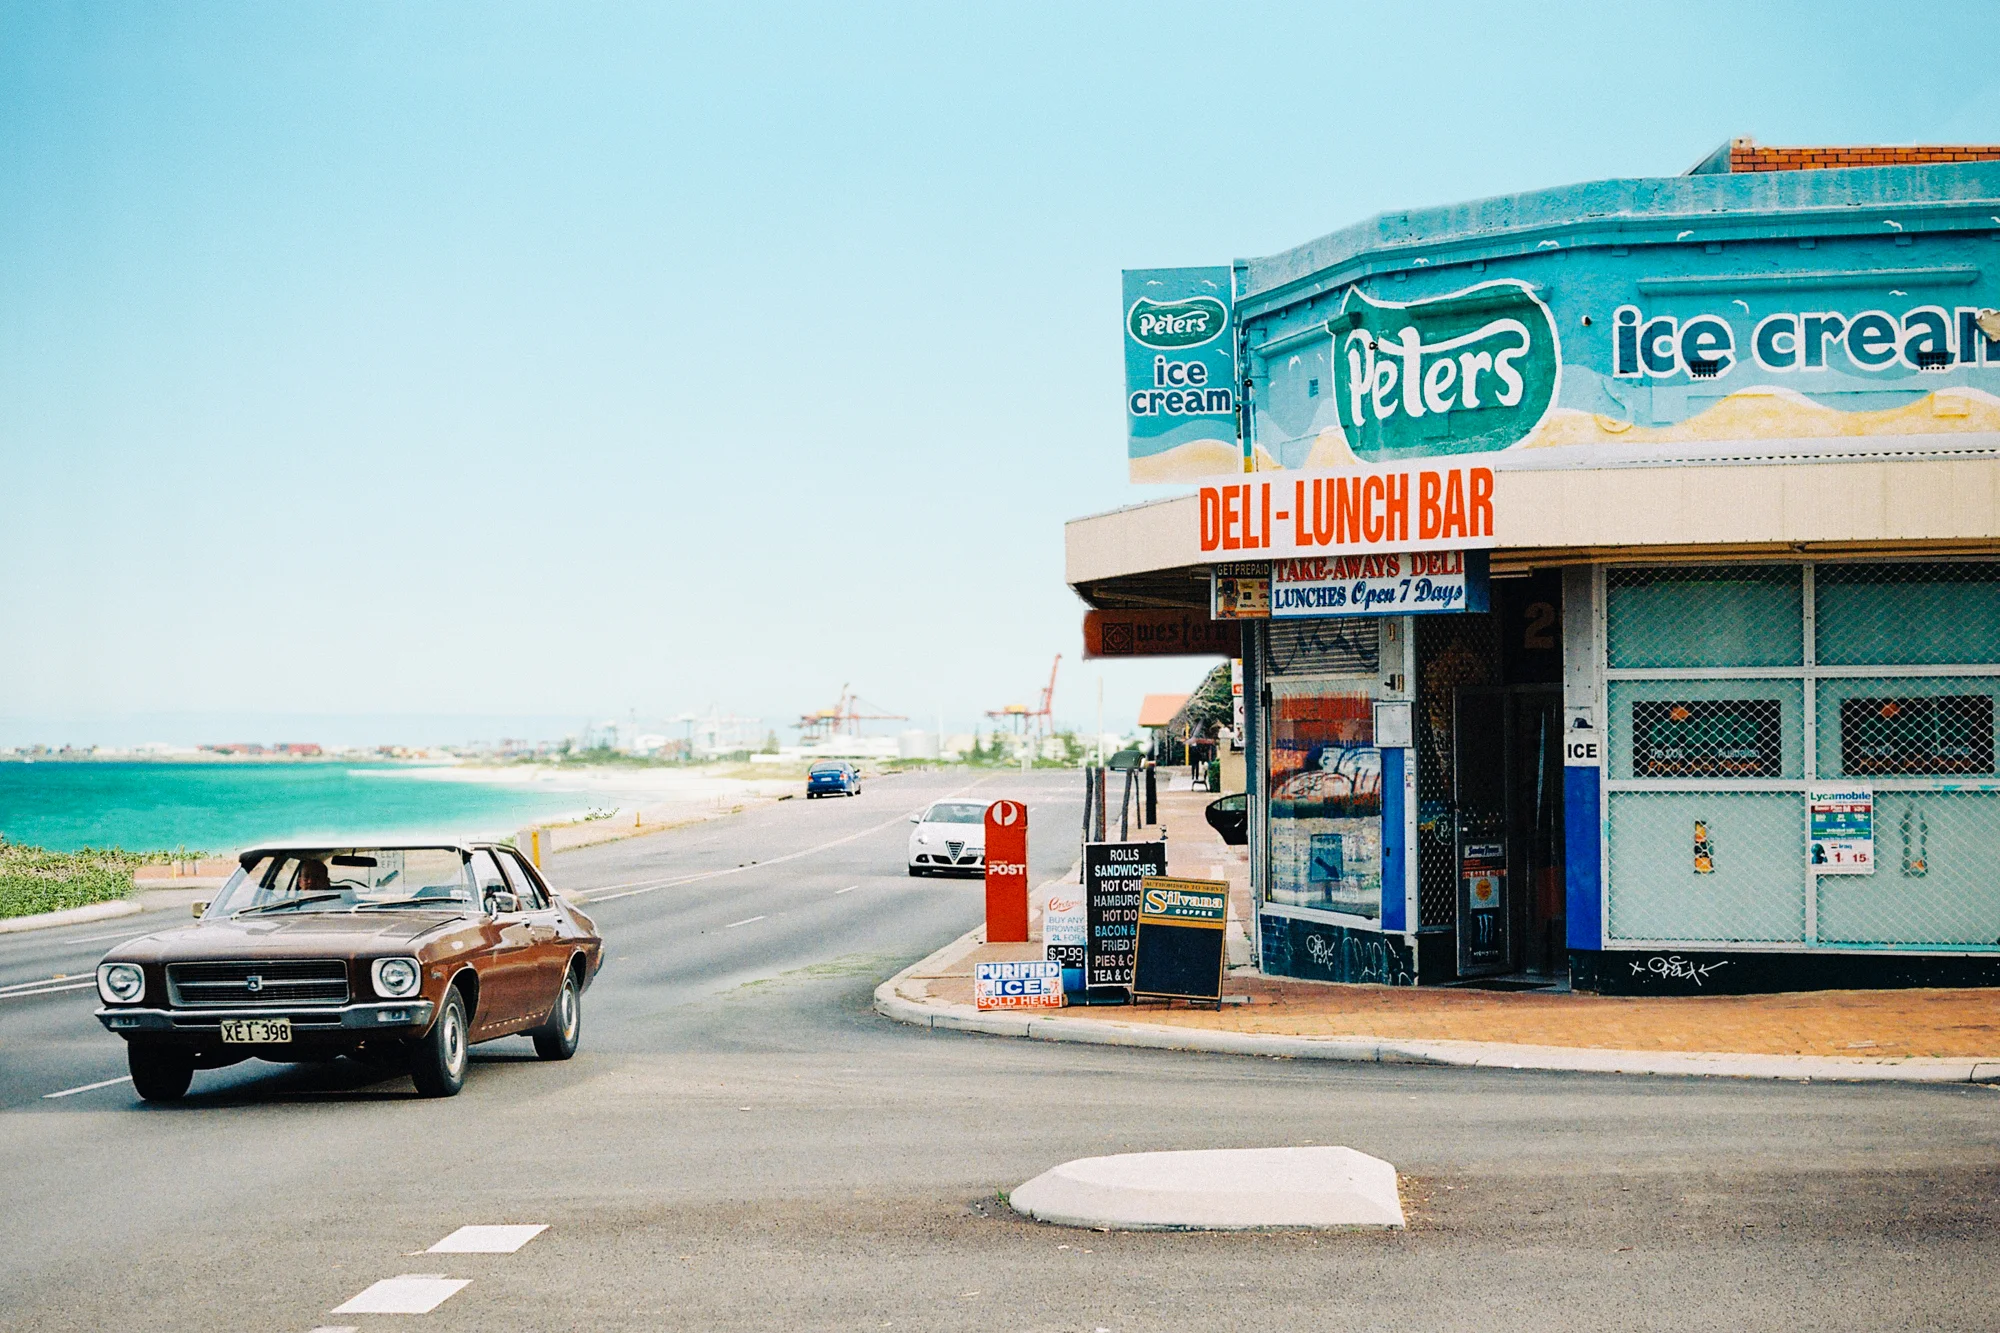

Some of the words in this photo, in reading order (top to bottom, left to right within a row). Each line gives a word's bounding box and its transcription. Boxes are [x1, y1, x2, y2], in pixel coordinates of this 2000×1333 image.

[1139, 309, 1210, 336] Peters
[1614, 305, 1736, 379] ice
[1154, 358, 1208, 386] ice
[1343, 318, 1530, 426] Peters
[1130, 387, 1232, 415] cream
[1418, 467, 1494, 541] BAR
[1217, 564, 1233, 576] GET
[1235, 563, 1269, 575] PREPAID
[1273, 553, 1400, 582] TAKE-AWAYS
[1410, 551, 1464, 576] DELI
[1274, 586, 1346, 609] LUNCHES
[1351, 581, 1396, 610] Open
[1399, 579, 1412, 602] 7
[1414, 578, 1464, 608] Days
[1567, 744, 1597, 758] ICE
[1810, 791, 1871, 801] Lycamobile
[1110, 849, 1139, 861] ROLLS
[989, 864, 1026, 875] POST
[1094, 864, 1157, 877] SANDWICHES
[1101, 880, 1120, 892] HOT
[1145, 890, 1223, 914] Silvana
[1102, 909, 1121, 922] HOT
[1123, 909, 1137, 921] DO
[1175, 908, 1213, 917] COFFEE
[1067, 916, 1085, 924] ANY
[1095, 925, 1128, 937] BACON
[1129, 924, 1136, 936] &
[1101, 940, 1130, 951] FRIED
[1095, 955, 1116, 967] PIES
[1118, 954, 1125, 967] &
[977, 962, 1058, 979] PURIFIED
[1094, 969, 1113, 981] TEA
[1114, 969, 1121, 981] &
[995, 981, 1040, 995] ICE
[979, 997, 1016, 1007] SOLD
[1020, 995, 1058, 1005] HERE
